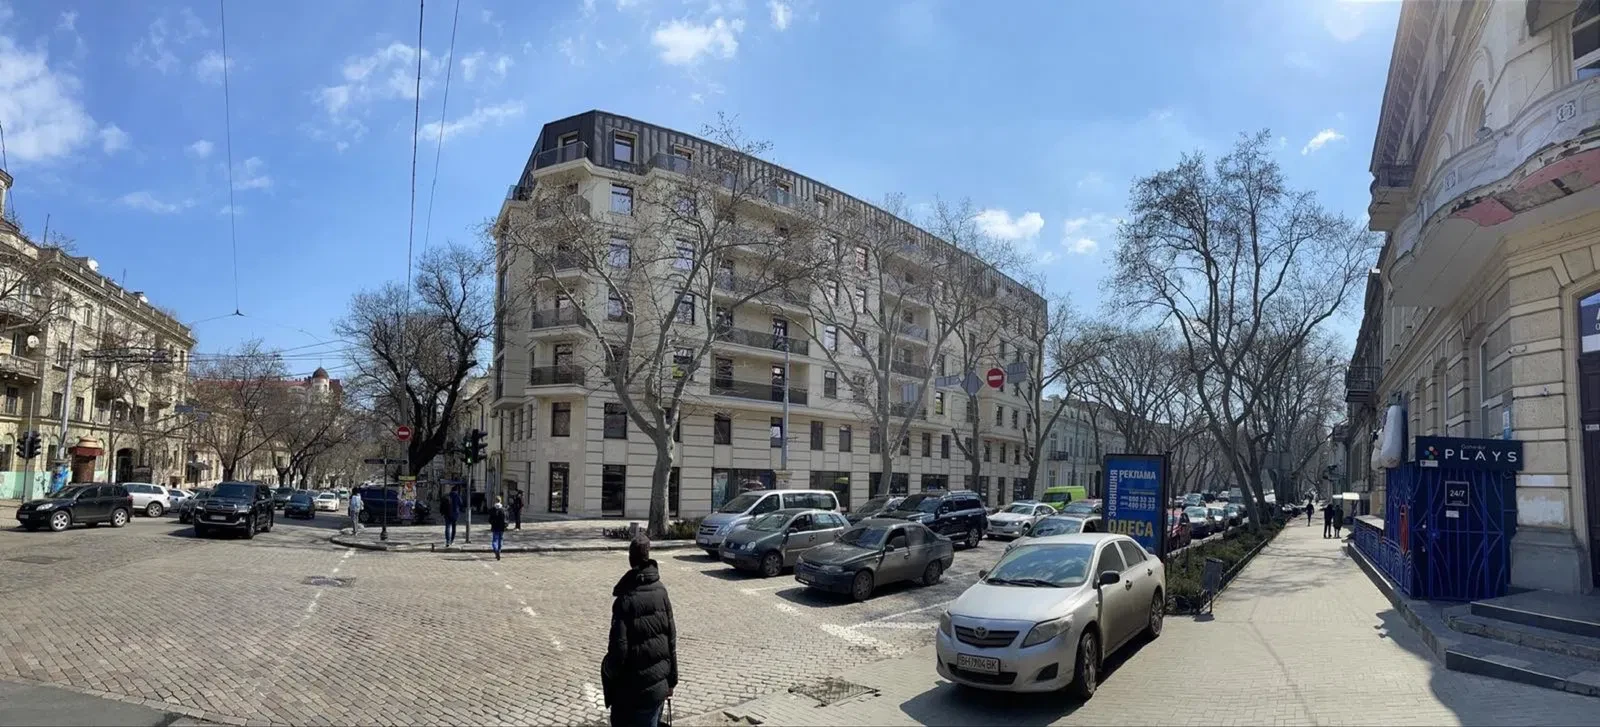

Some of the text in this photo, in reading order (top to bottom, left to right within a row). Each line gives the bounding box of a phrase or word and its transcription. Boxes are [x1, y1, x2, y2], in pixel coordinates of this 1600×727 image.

[1445, 449, 1517, 462] PLAYS
[1119, 470, 1156, 480] РЕКЛАМА
[1109, 469, 1118, 517] ЗОВНІШНЯ
[1107, 519, 1153, 537] ОДЕСА
